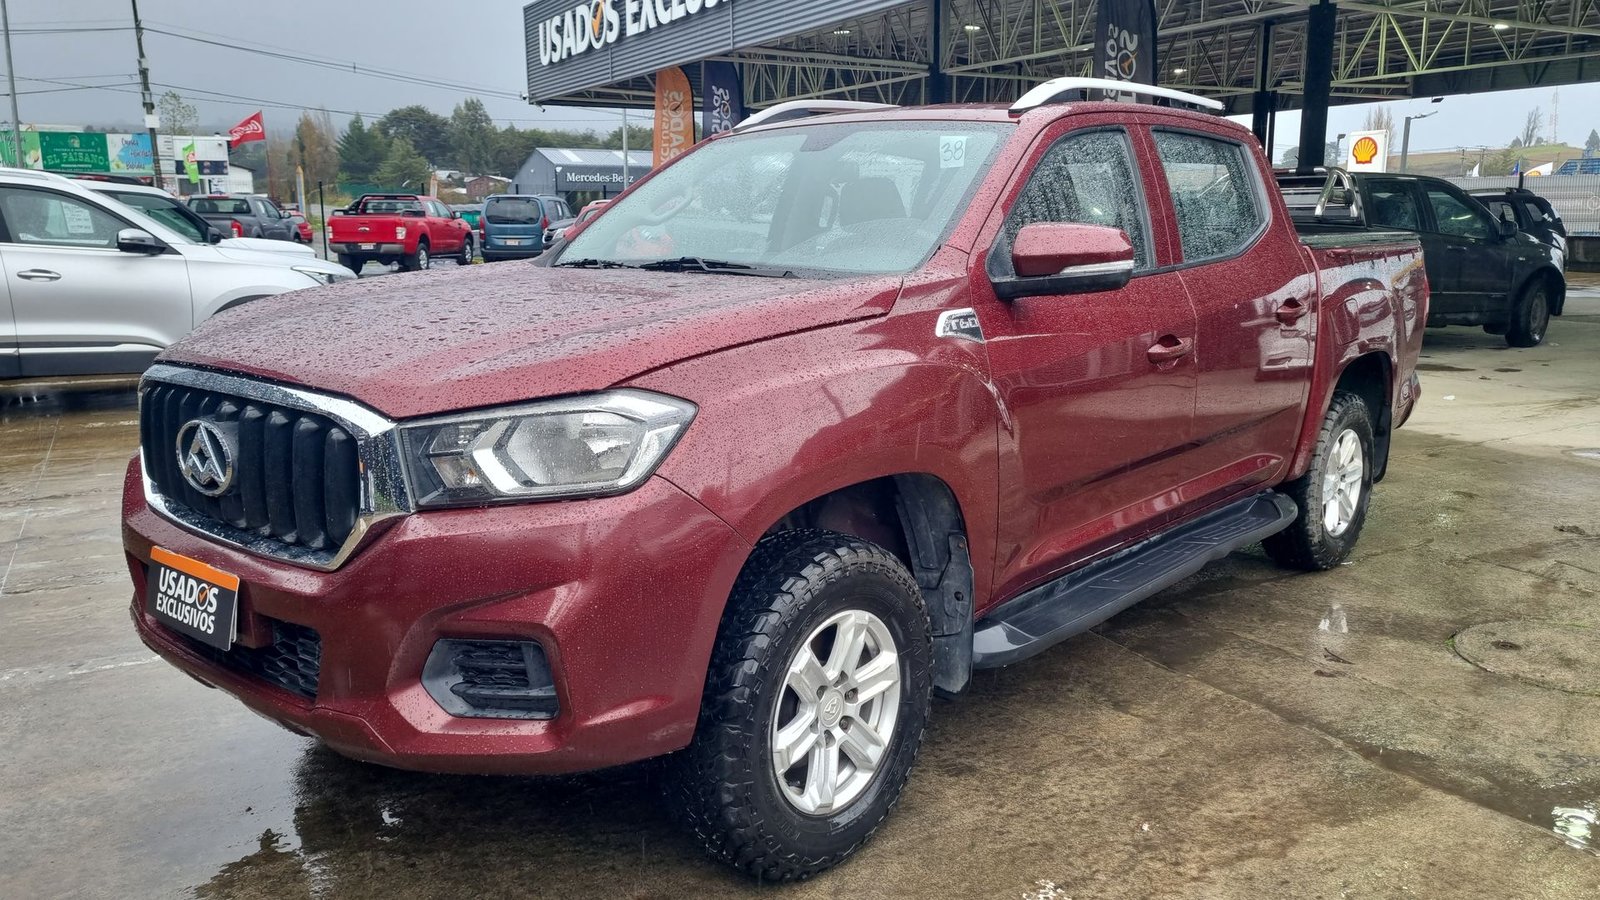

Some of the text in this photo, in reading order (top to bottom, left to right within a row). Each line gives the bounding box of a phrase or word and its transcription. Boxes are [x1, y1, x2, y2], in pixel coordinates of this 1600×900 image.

[539, 0, 730, 66] USADOS EXCL
[941, 140, 965, 162] 38
[566, 172, 634, 183] Mercedes-Bez
[159, 566, 219, 613] USADOS
[156, 592, 216, 635] EXCLUSIVOS
